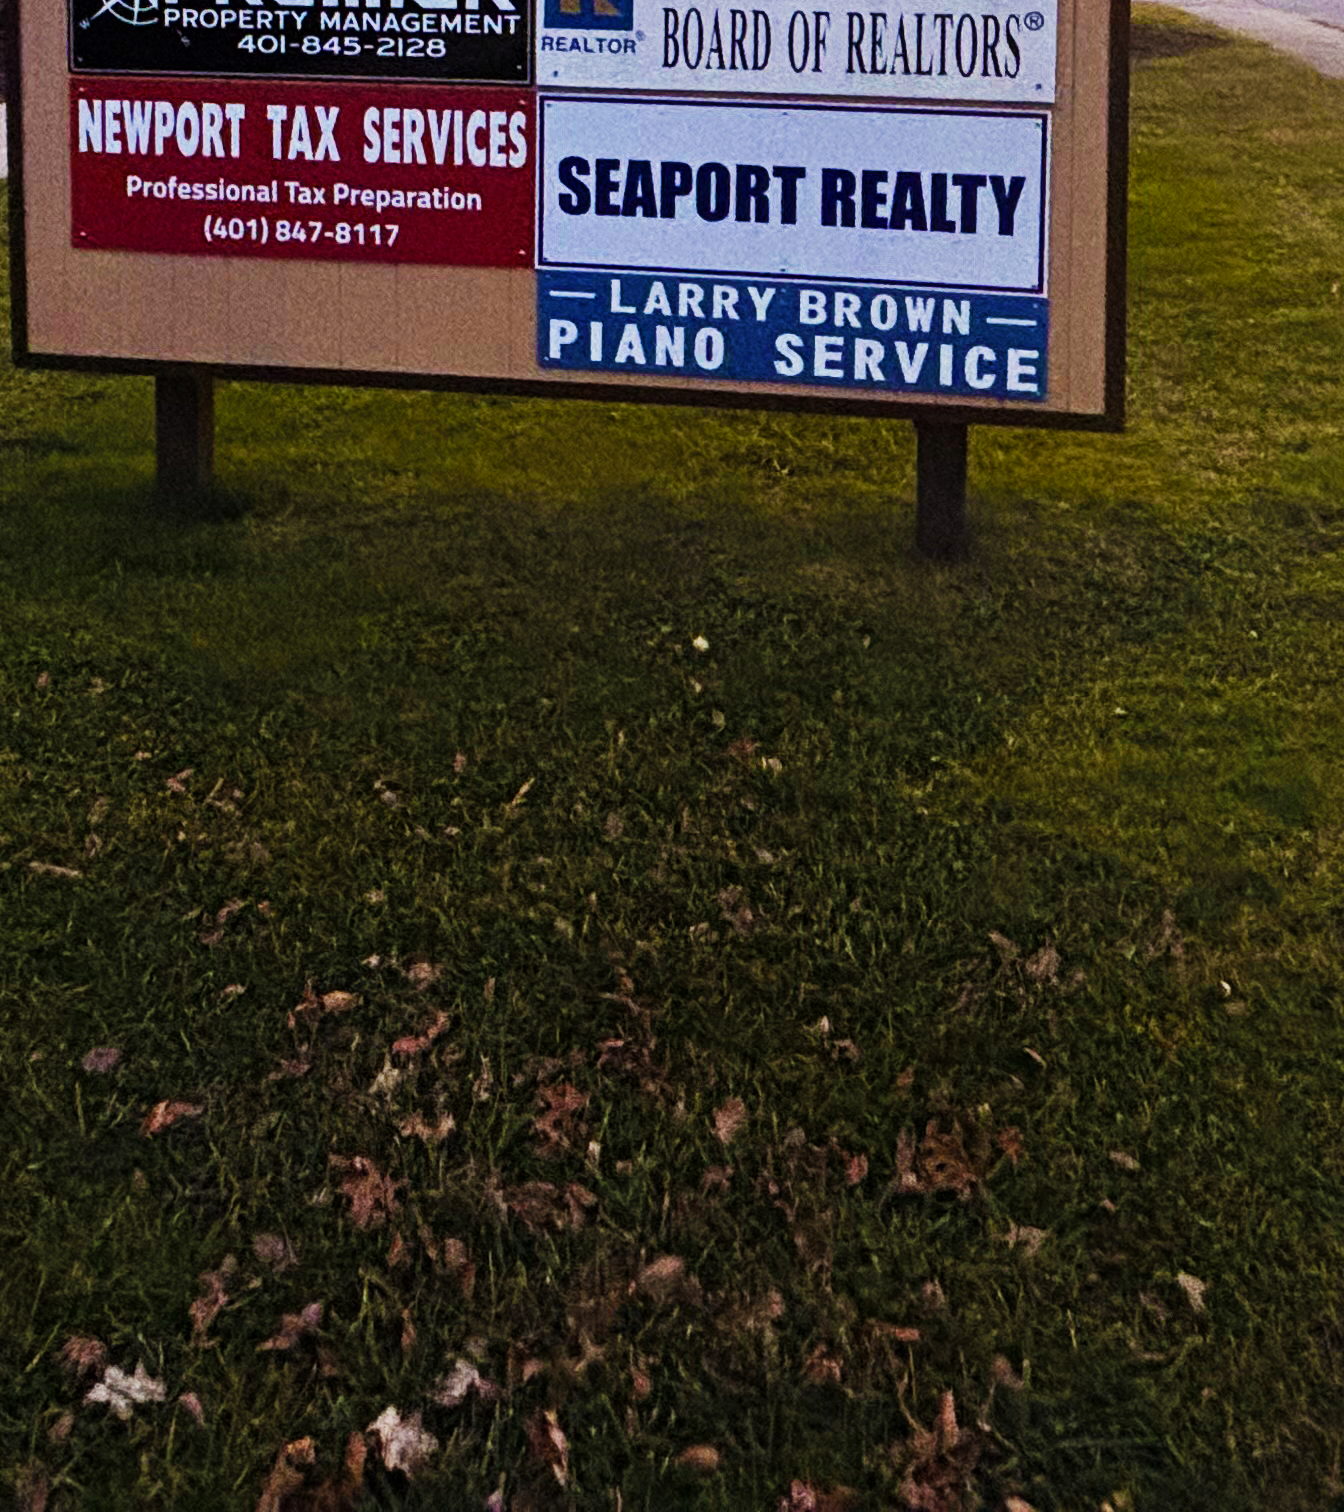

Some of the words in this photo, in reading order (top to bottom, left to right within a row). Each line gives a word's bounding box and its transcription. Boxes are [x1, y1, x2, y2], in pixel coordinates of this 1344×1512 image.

[163, 8, 307, 31] PROPERTY
[320, 11, 521, 35] MANAGEMENT
[237, 34, 446, 58] 401-845-2128
[662, 7, 773, 71] BOARD
[787, 10, 832, 72] OF
[77, 98, 246, 158] NEWPORT
[266, 104, 341, 161] TAX
[362, 106, 527, 168] SERVICES
[126, 175, 278, 203] Professional
[284, 180, 326, 205] Tax
[333, 182, 483, 212] Preparation
[557, 155, 806, 226] SEAPORT
[820, 167, 1027, 236] REALTY
[203, 217, 269, 243] (401)
[275, 220, 400, 246] 847-8117
[610, 279, 776, 322] LARRY
[798, 289, 972, 336] BROWN
[549, 319, 725, 370] PIANO
[773, 333, 1041, 394] SERVICE
